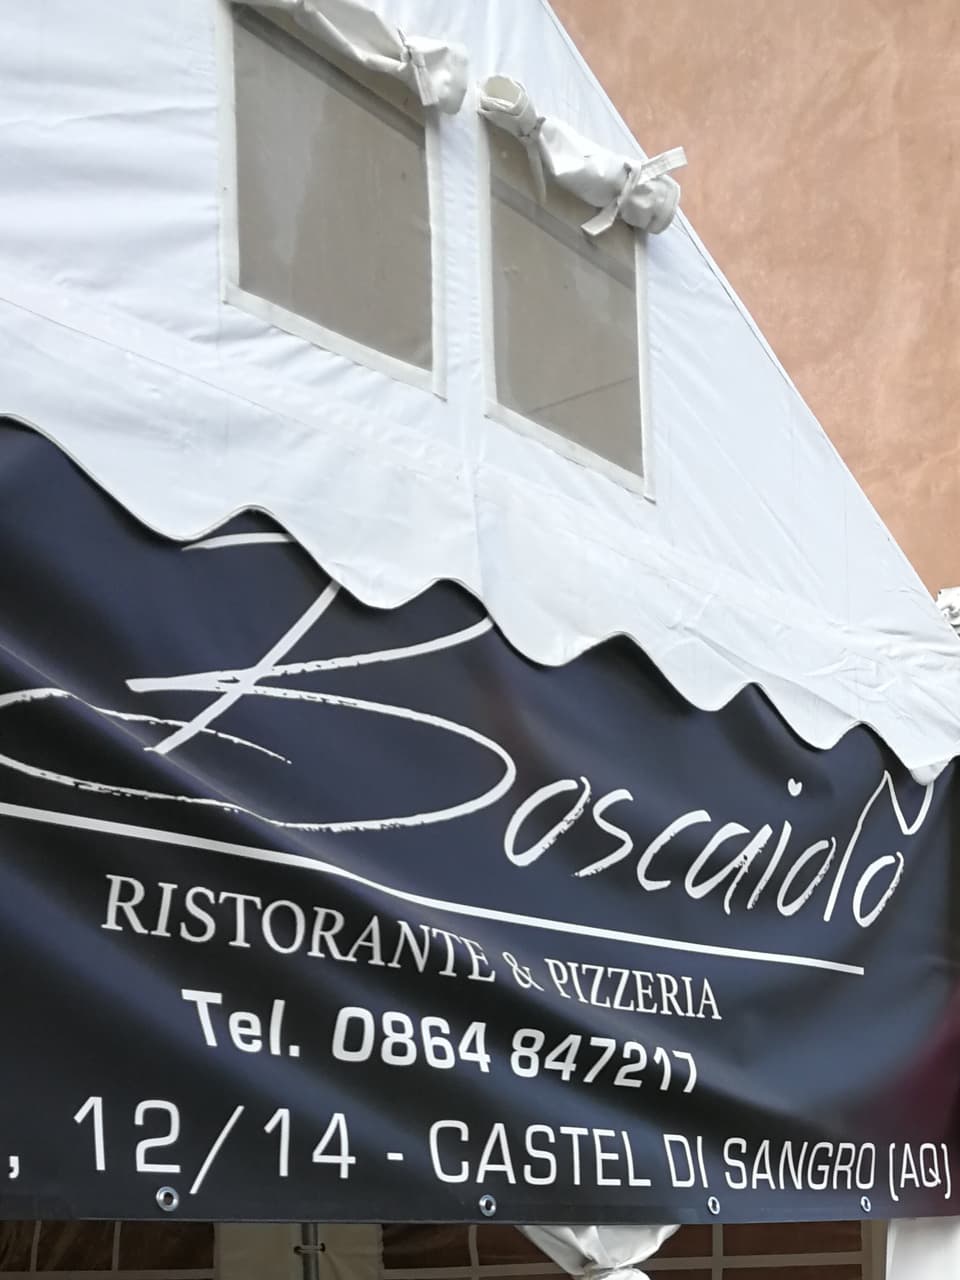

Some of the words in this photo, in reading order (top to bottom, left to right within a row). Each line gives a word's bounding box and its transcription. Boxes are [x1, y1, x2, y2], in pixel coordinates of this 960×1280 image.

[101, 874, 497, 983] RISTORANTE
[502, 951, 545, 992] &
[543, 957, 723, 1021] PIZZERIA
[180, 988, 301, 1058] Tel.
[332, 1006, 492, 1073] 0864
[510, 1028, 698, 1093] 847217
[73, 1096, 357, 1195] 12/14
[429, 1119, 652, 1187] CASTEL
[662, 1133, 709, 1190] DI
[723, 1137, 876, 1191] SANGRO
[887, 1142, 952, 1202] (AQ)
